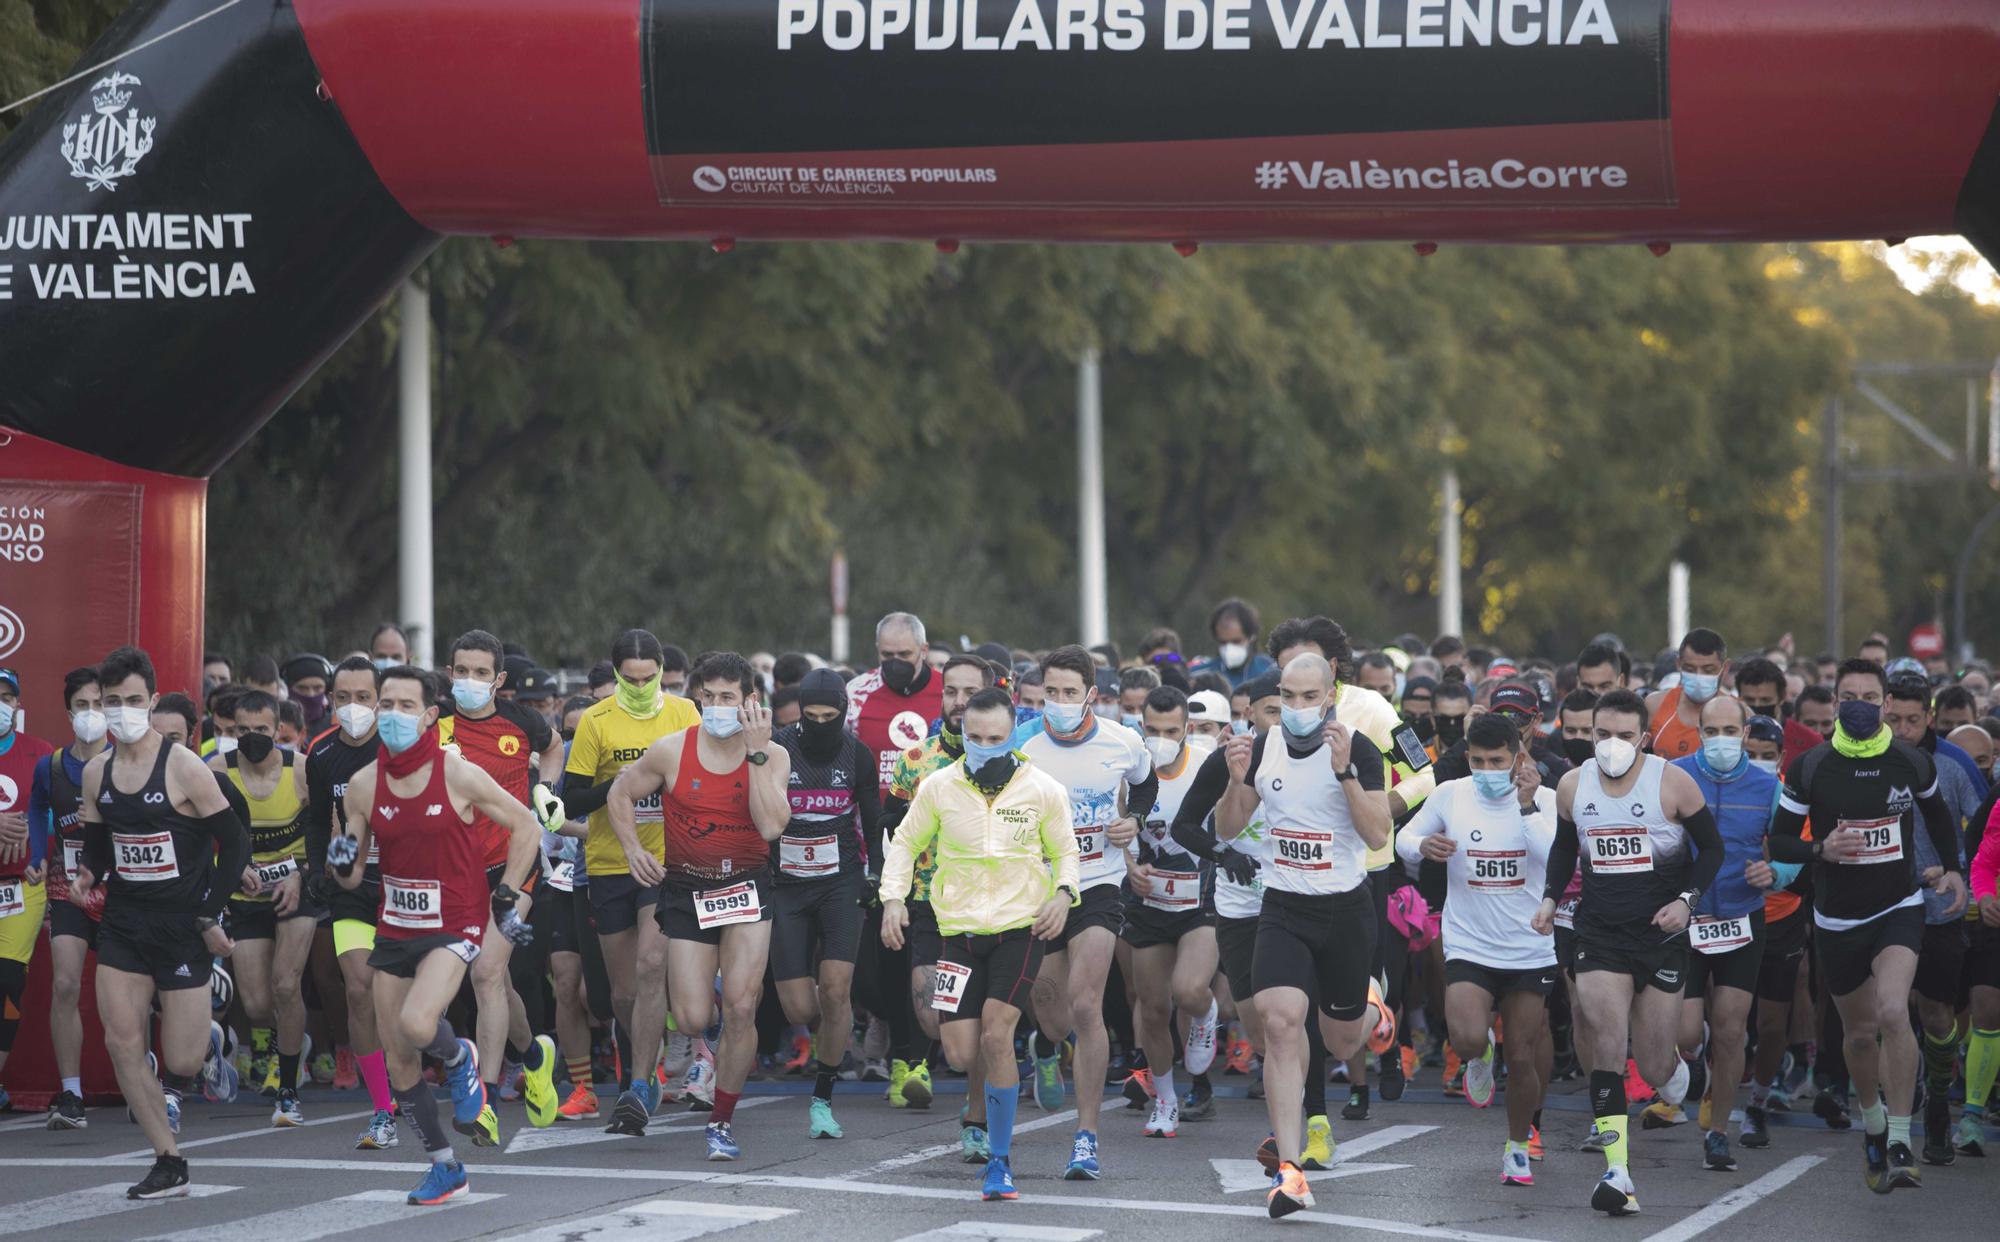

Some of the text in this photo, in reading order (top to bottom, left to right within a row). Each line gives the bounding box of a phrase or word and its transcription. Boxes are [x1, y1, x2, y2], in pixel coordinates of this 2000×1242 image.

[778, 0, 1146, 51] POPULARS
[1164, 0, 1251, 50] DE
[728, 167, 997, 183] CIRCUIT DE CARRERES POPULARS
[1255, 159, 1628, 189] #ValènciaCorre
[731, 182, 785, 193] CIUTAT
[791, 182, 811, 194] DE
[29, 255, 256, 299] VALÈNCIA
[122, 845, 164, 864] 5342
[804, 847, 815, 861] 3
[1279, 839, 1322, 860] 6994
[1597, 837, 1642, 856] 6636
[1475, 860, 1518, 877] 5615
[1165, 880, 1175, 895] 4
[392, 889, 429, 911] 4488
[705, 893, 750, 912] 6999
[1698, 921, 1742, 940] 5385
